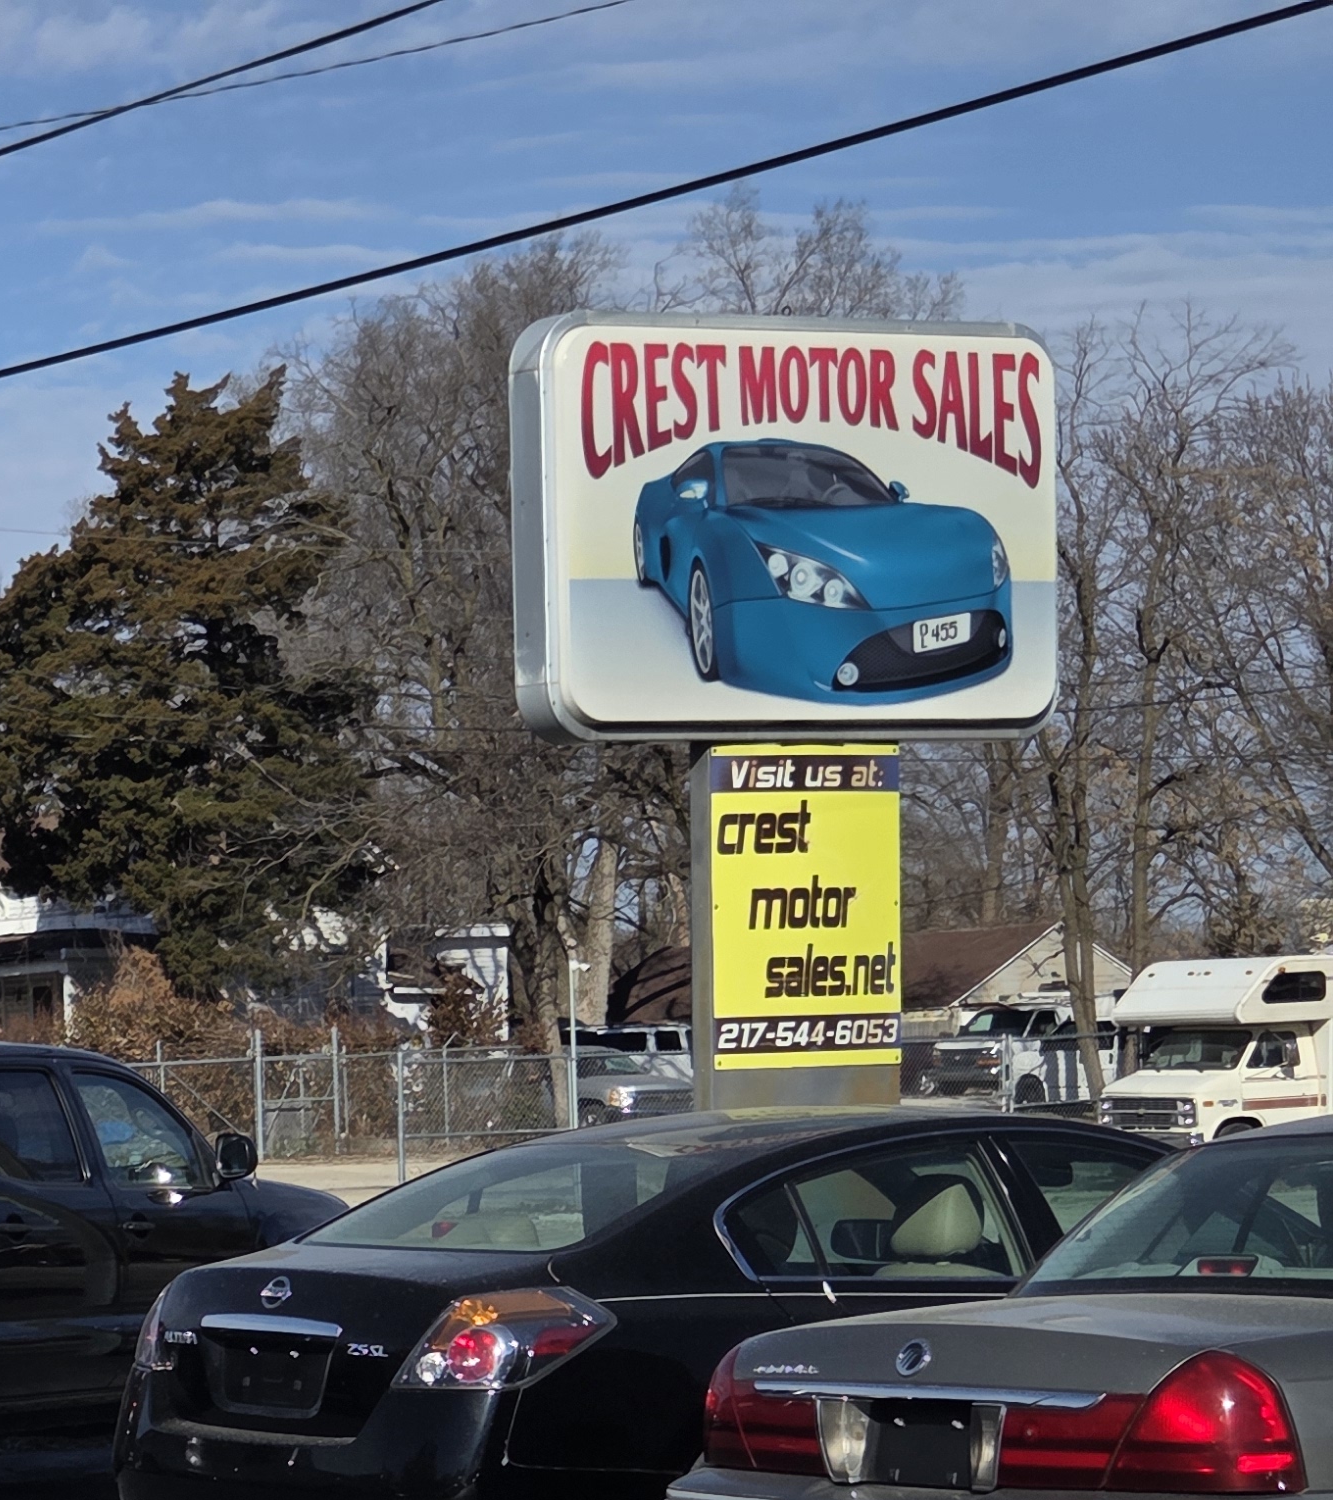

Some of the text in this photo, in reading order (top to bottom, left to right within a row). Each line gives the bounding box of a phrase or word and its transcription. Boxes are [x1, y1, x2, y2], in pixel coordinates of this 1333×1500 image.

[581, 341, 1042, 489] CREST MOTOR SALES
[931, 620, 958, 643] 455
[731, 759, 884, 789] Visit us at:
[717, 800, 811, 855] crest
[749, 875, 856, 929] motor
[765, 941, 896, 998] sales.net
[718, 1018, 899, 1049] 217-544-6053
